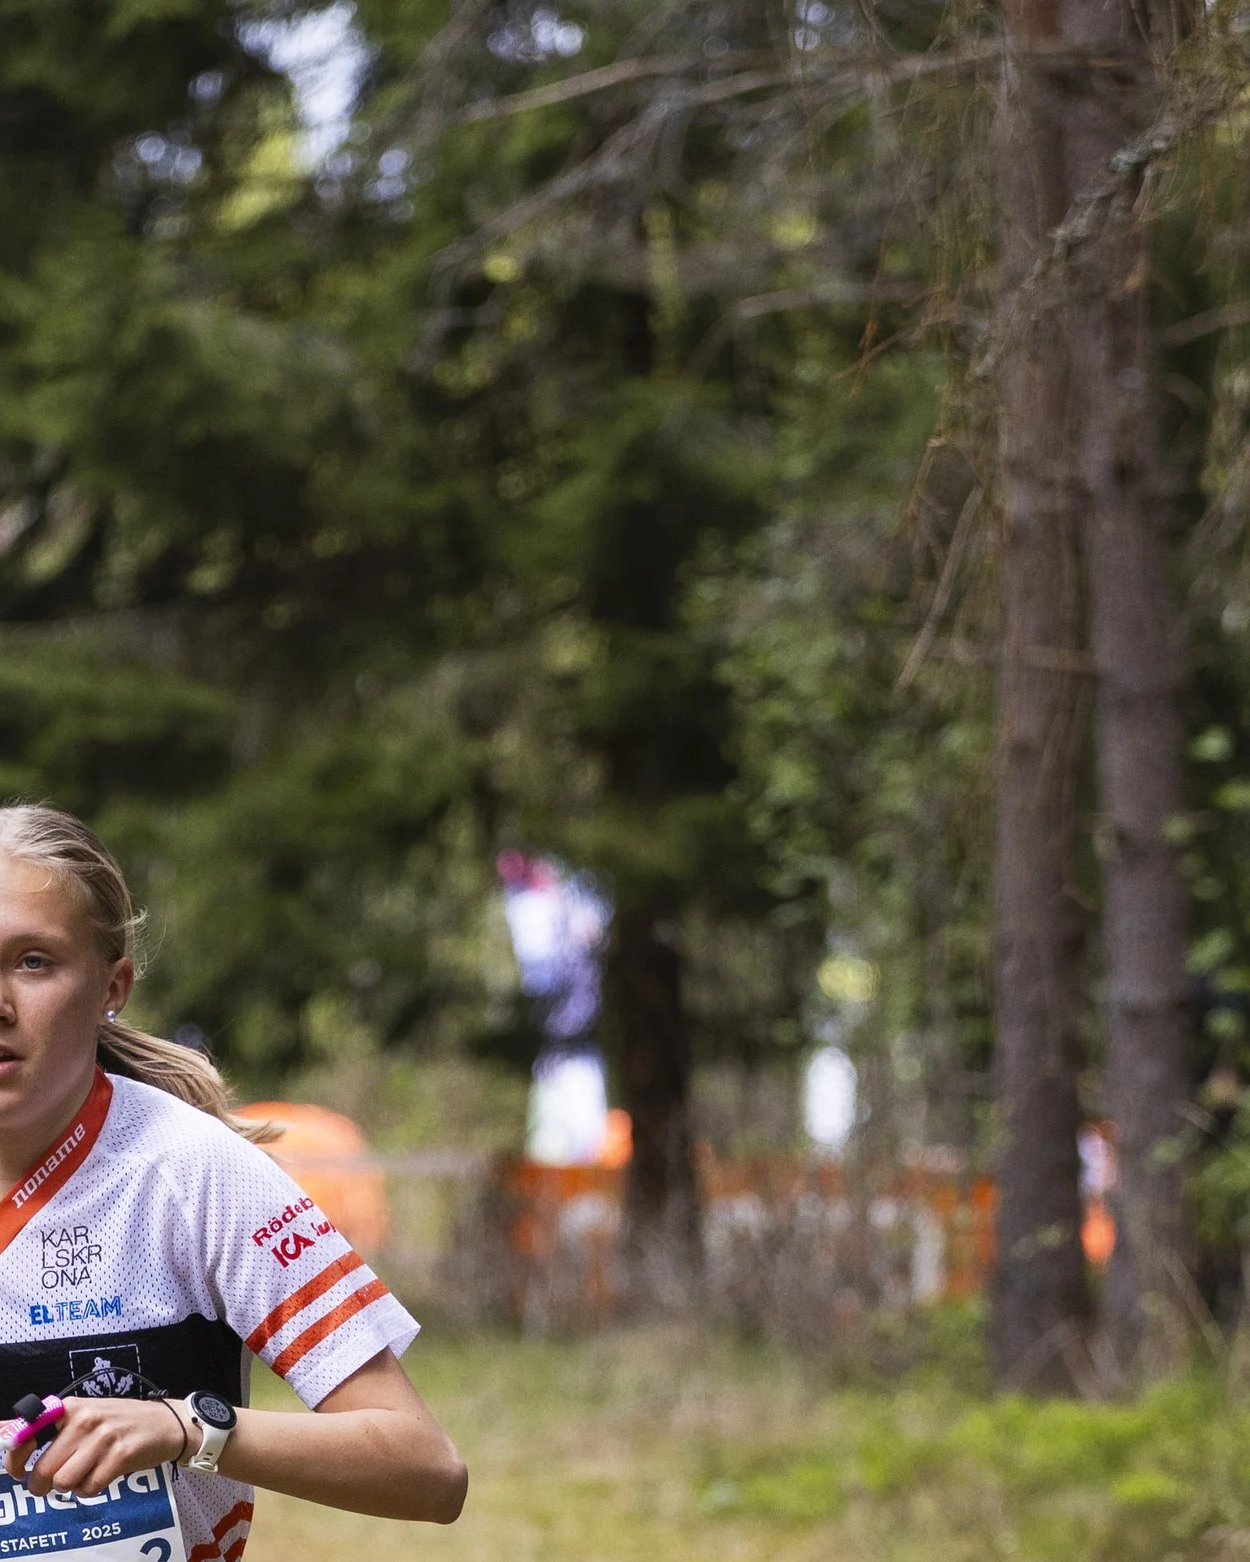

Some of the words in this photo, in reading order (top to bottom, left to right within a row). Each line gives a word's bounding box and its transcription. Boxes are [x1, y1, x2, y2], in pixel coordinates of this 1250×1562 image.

[12, 1123, 86, 1209] noname
[40, 1225, 90, 1250] KAR
[41, 1243, 102, 1270] LSKR
[41, 1266, 92, 1290] ONA
[0, 1531, 68, 1553] STAFETT
[81, 1521, 122, 1542] 2025
